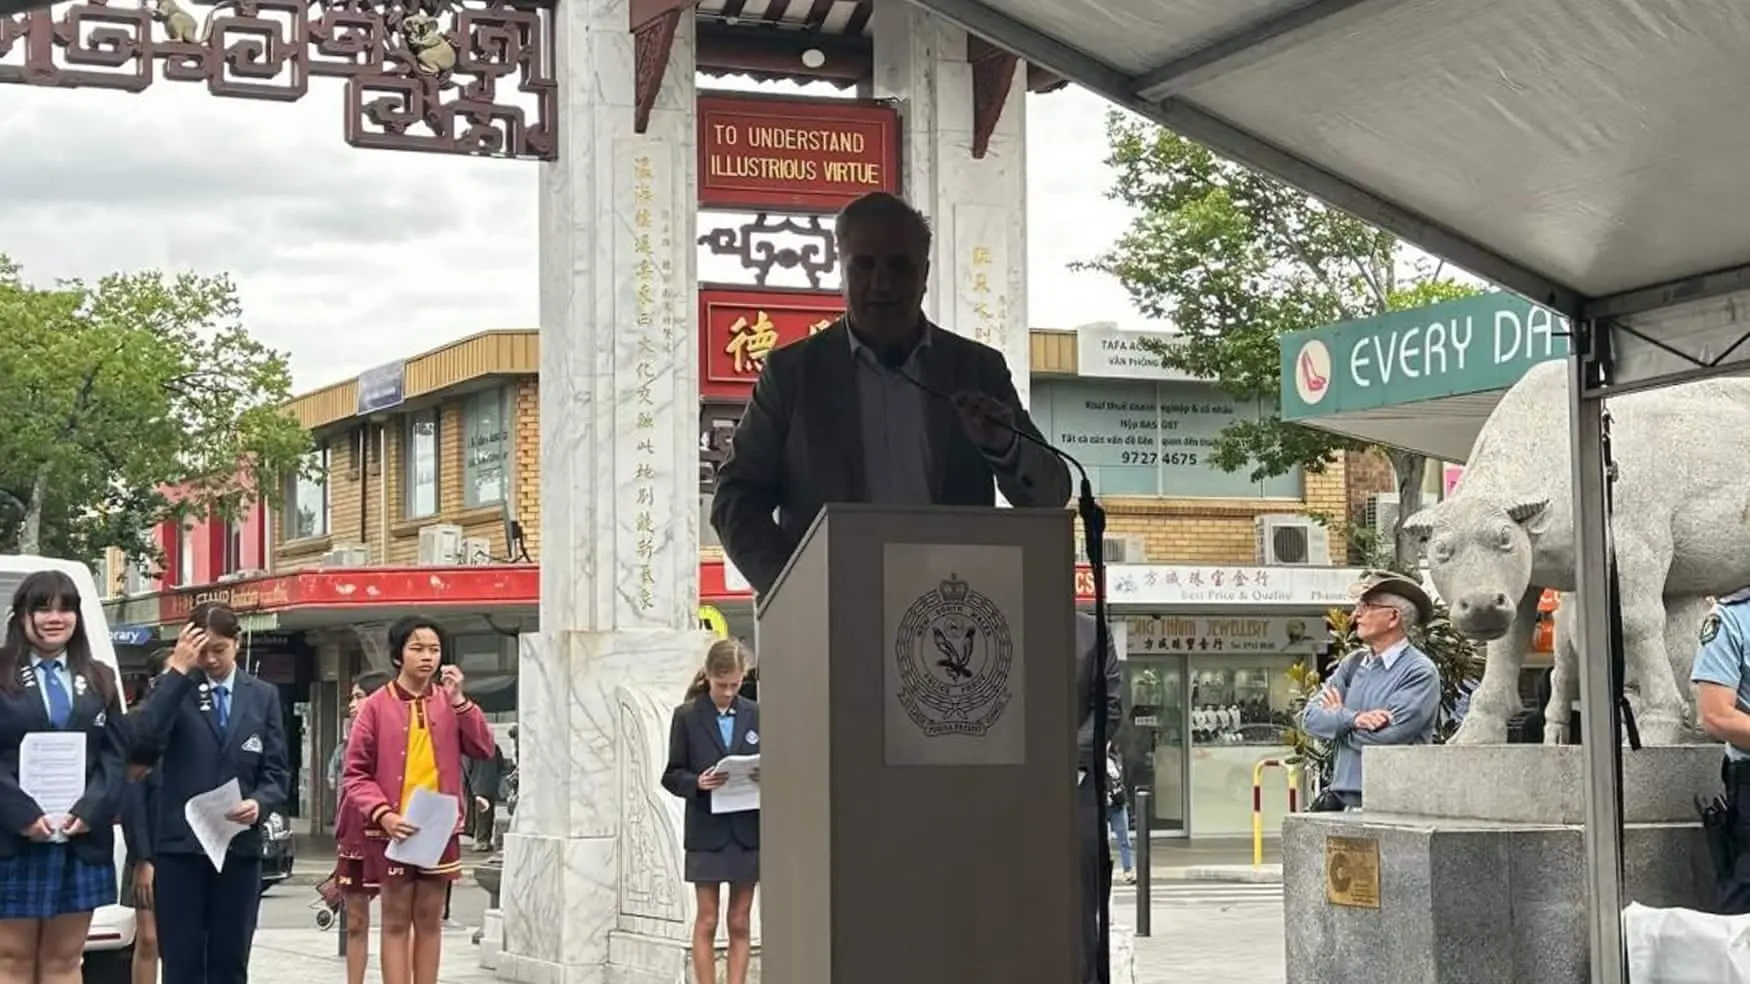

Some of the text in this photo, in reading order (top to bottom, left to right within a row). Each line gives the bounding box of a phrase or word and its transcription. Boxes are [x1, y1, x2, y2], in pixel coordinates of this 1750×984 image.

[713, 124, 865, 153] TO UNDERSTAND
[710, 155, 880, 184] ILLUSTRIOUS VIRTUE
[725, 310, 780, 373] 德
[1350, 315, 1473, 387] EVERY
[1121, 451, 1198, 466] 9727 4675
